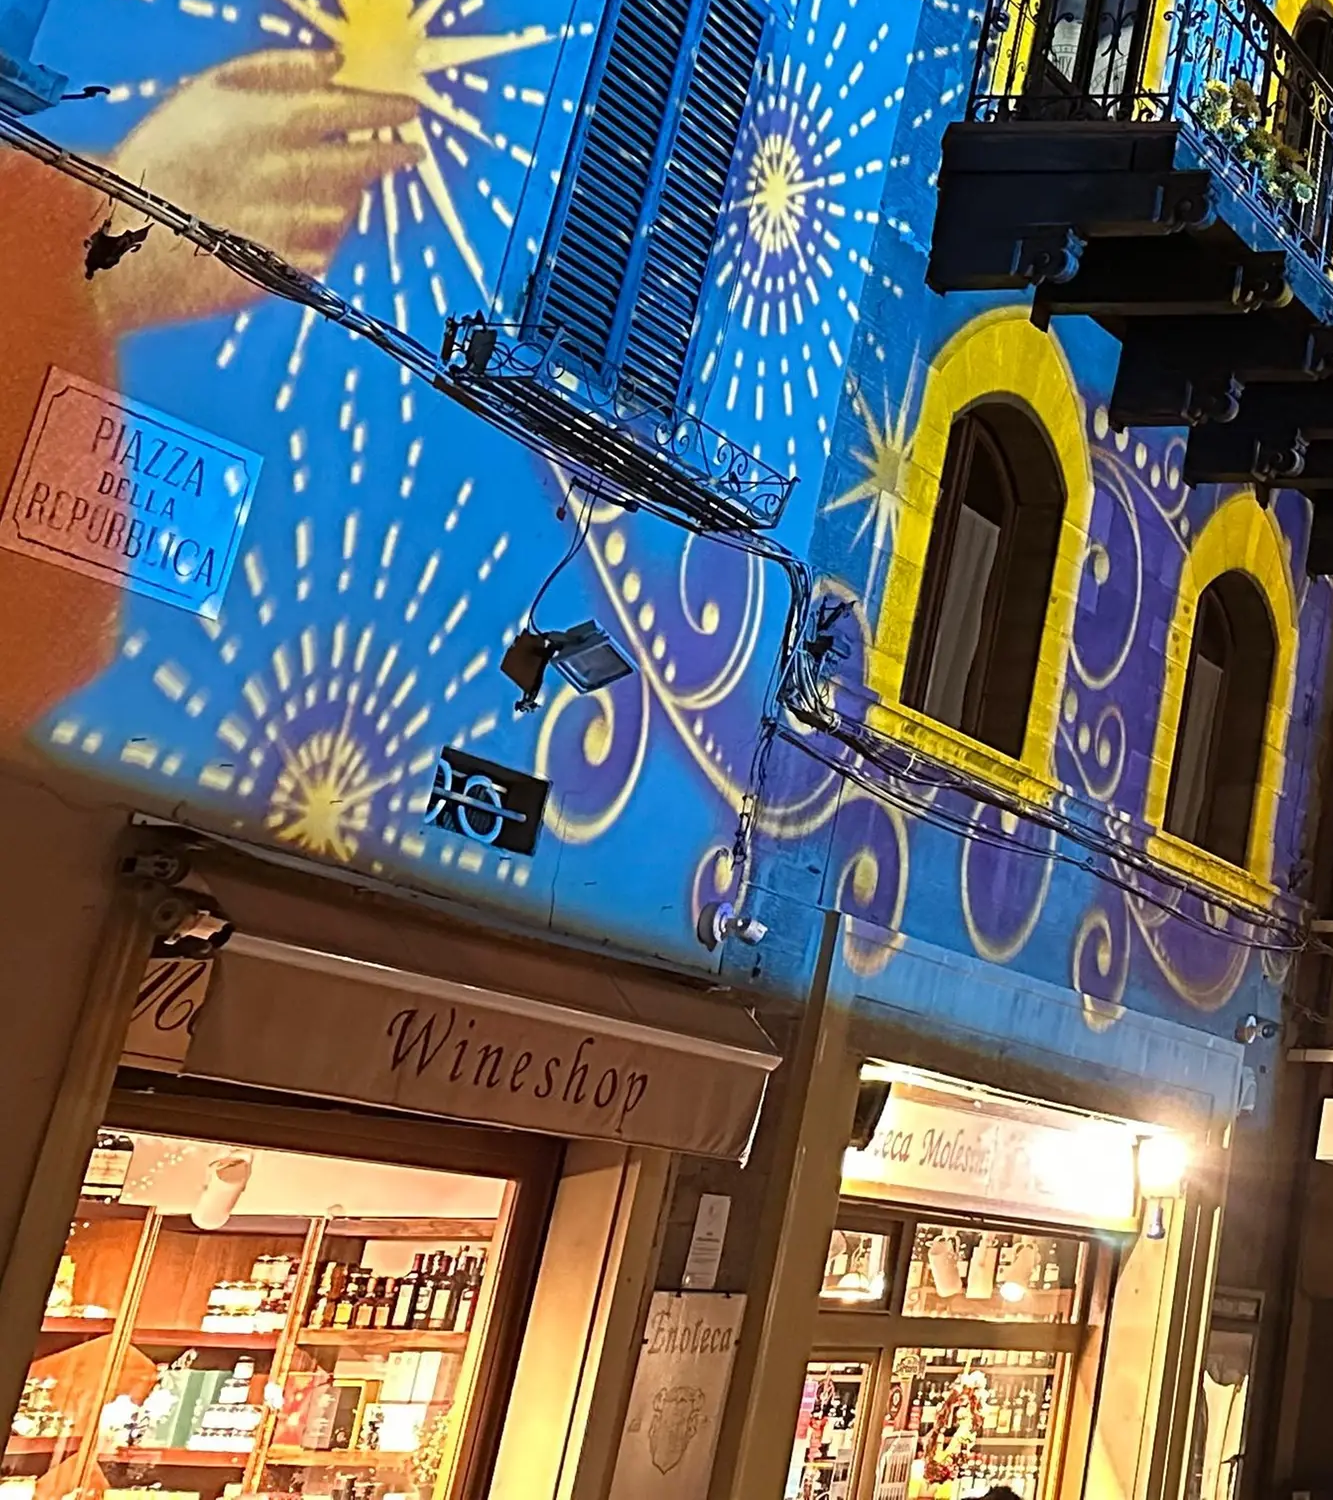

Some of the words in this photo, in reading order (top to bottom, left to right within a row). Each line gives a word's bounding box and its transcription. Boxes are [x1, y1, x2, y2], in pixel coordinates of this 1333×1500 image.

[92, 415, 205, 497] PIAZZA
[97, 470, 175, 518] DELLA
[26, 482, 216, 587] REPUBBLICA
[387, 1007, 649, 1133] Wineshop
[647, 1309, 733, 1357] Enoteca
